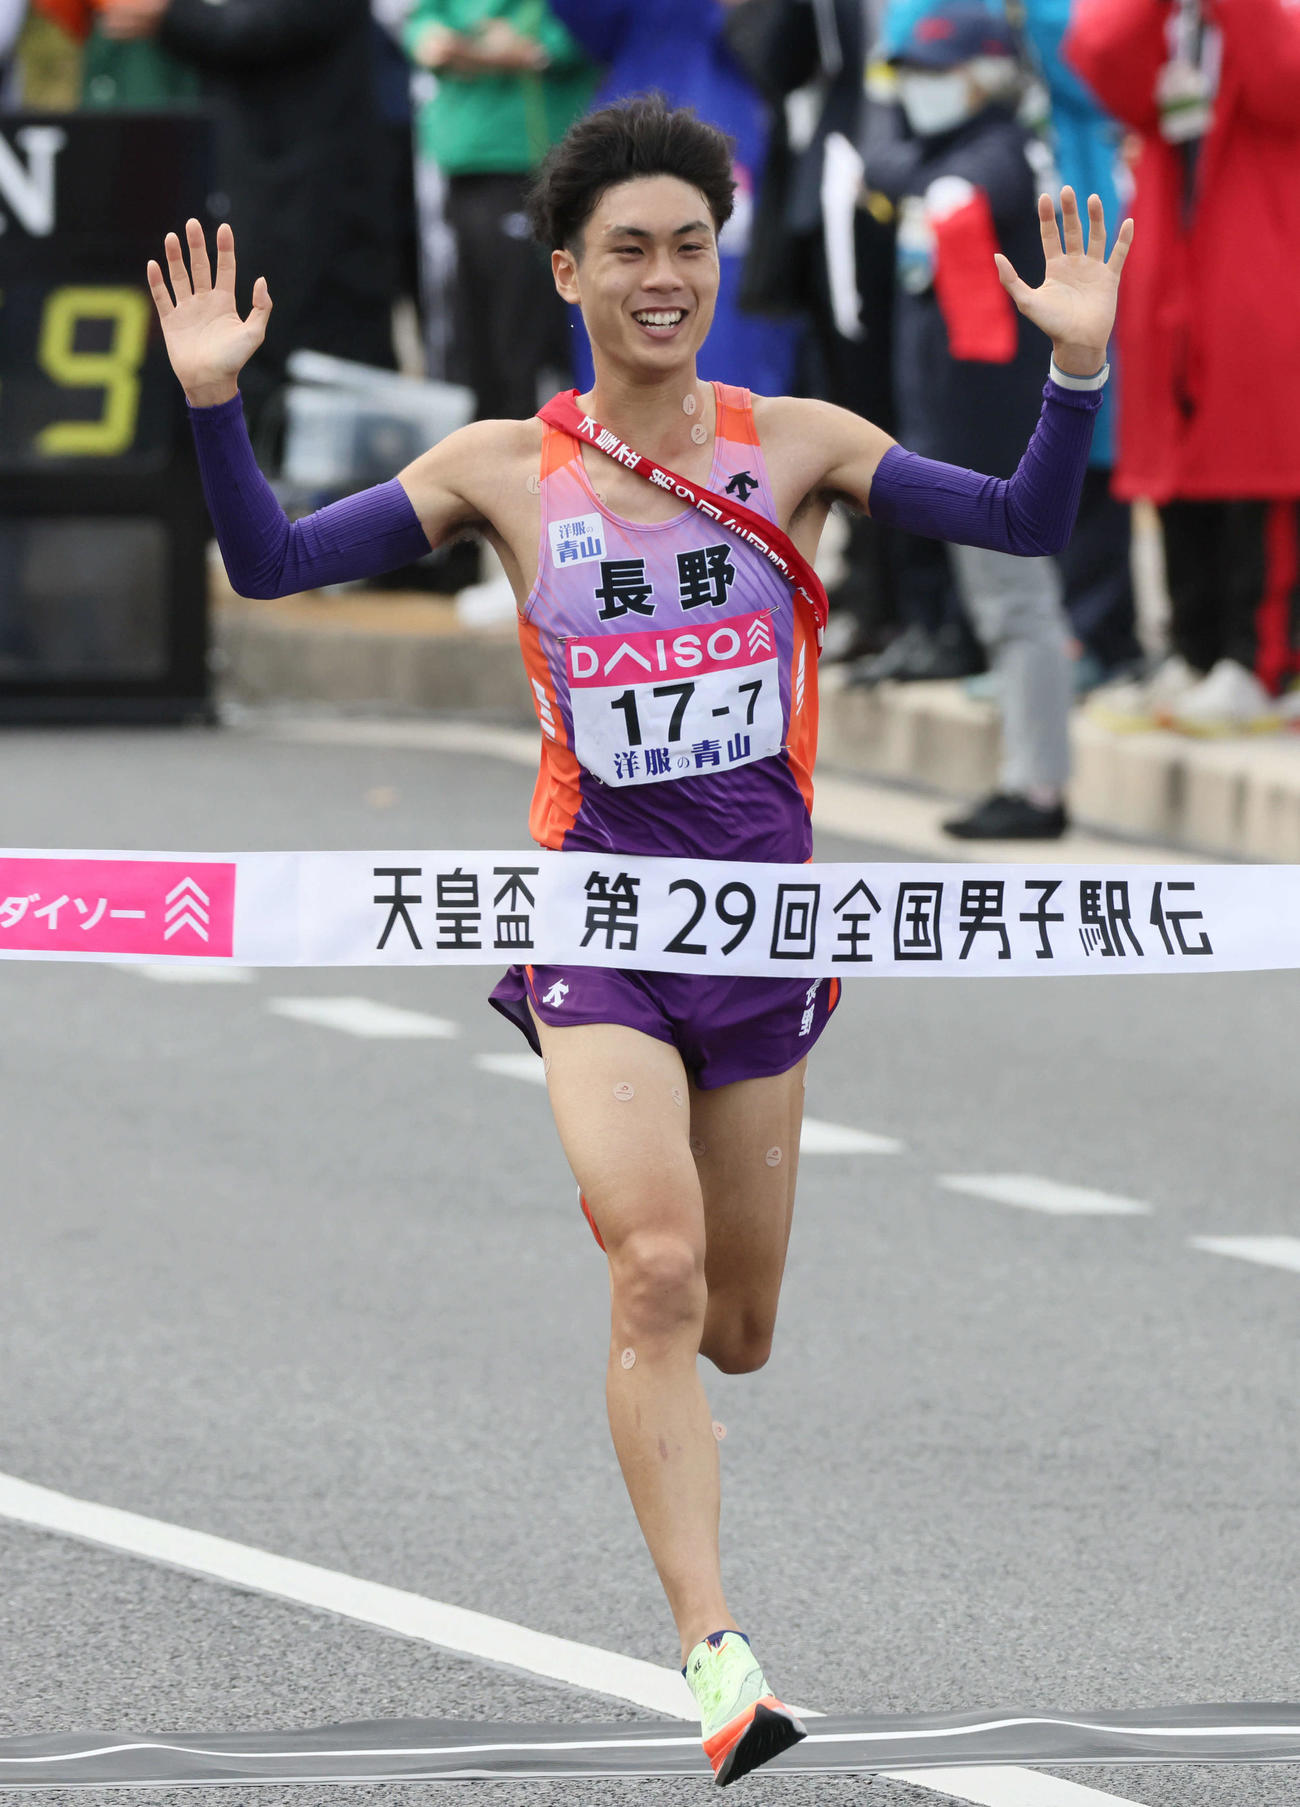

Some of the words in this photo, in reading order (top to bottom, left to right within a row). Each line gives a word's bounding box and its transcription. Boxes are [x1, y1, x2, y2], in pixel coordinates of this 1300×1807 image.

[556, 536, 602, 563] 青山
[594, 543, 737, 621] 長野
[571, 628, 741, 679] DAISO
[614, 733, 751, 780] 洋服の青山
[0, 893, 146, 930] ダイソー
[373, 867, 540, 950] 天皇盃
[580, 870, 1214, 963] 第29回全国男子駅伝
